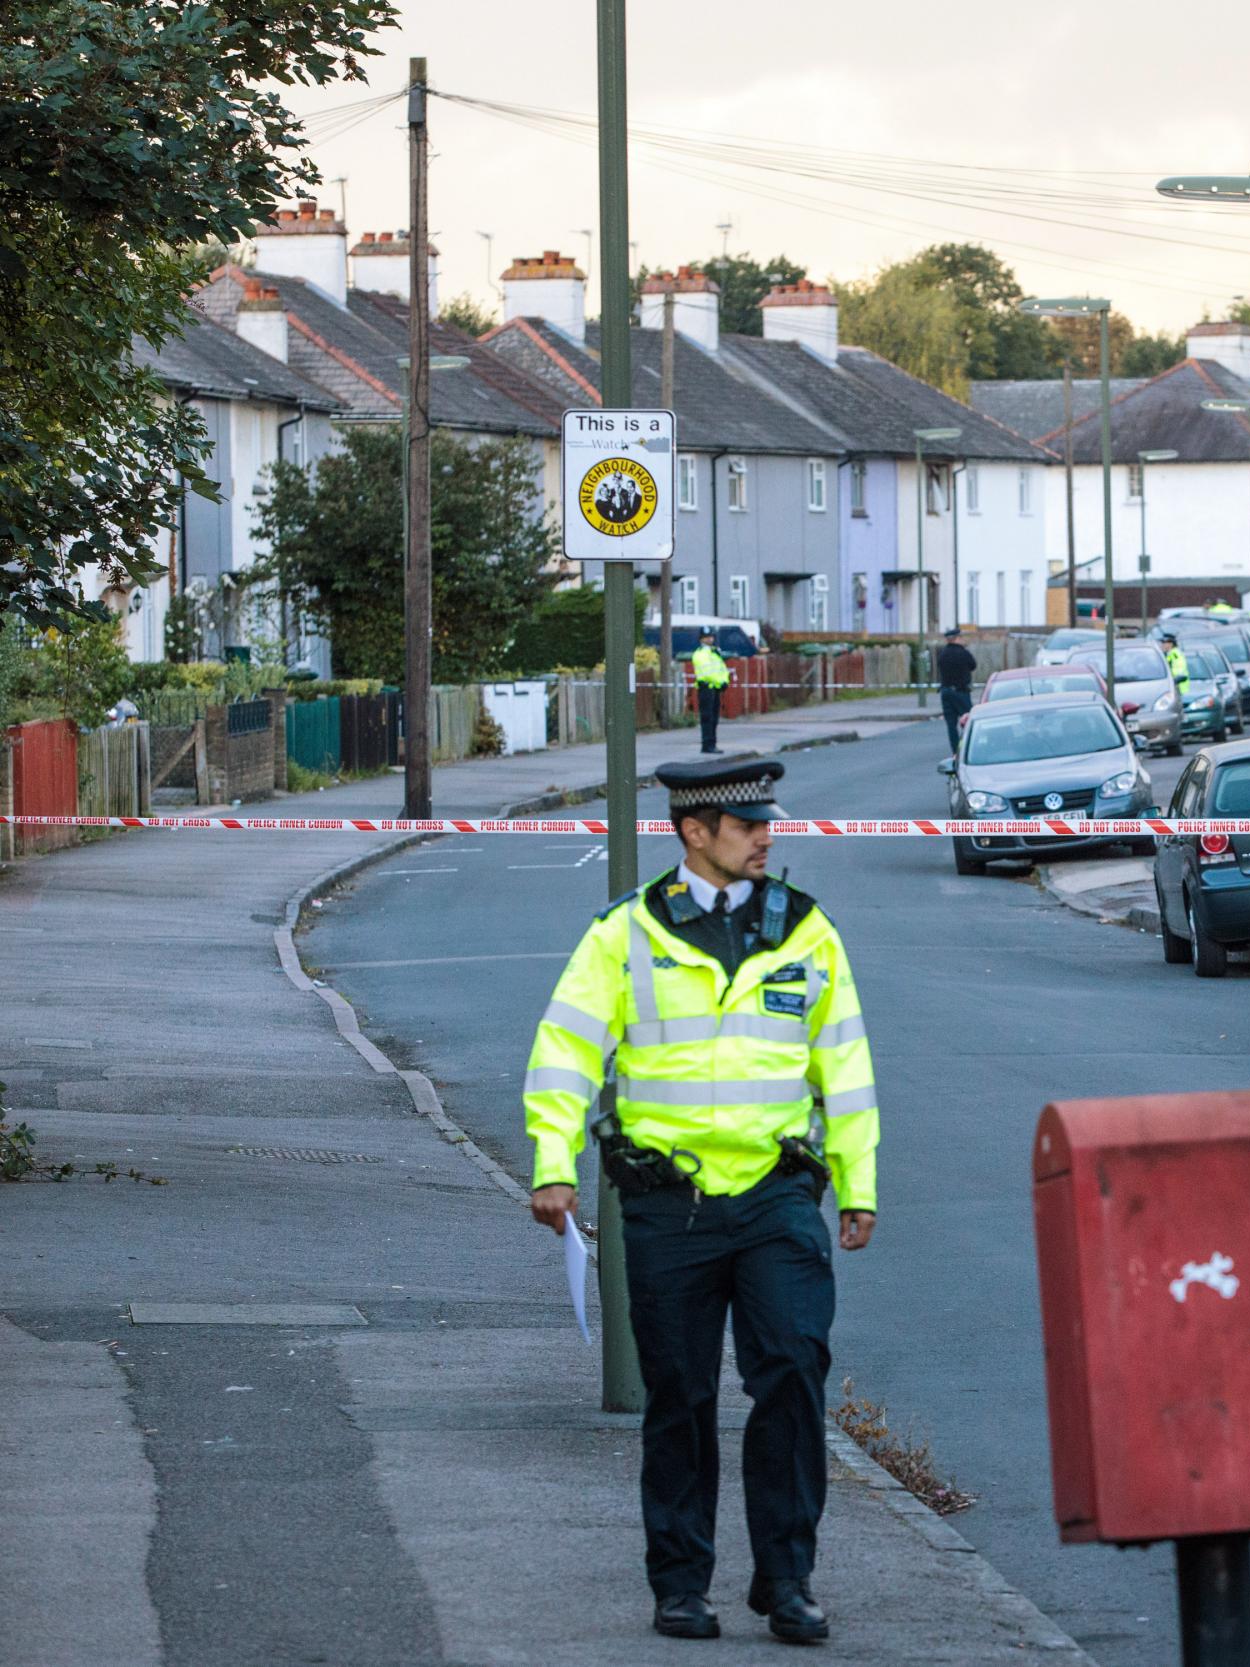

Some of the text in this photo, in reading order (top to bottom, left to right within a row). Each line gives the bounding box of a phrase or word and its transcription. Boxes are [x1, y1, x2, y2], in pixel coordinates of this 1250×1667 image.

[576, 415, 660, 431] This is a
[582, 460, 655, 503] NEIGHBOURHOOD
[598, 520, 639, 535] WATCH
[75, 817, 110, 825] CORDON
[148, 818, 159, 826] DO
[181, 819, 210, 827] CROSS
[247, 819, 343, 829] POLICE INNER CORDON
[382, 820, 444, 830] DO NOT CROSS
[481, 821, 577, 831] POLICE INNER CORDON
[636, 822, 645, 832] OT
[774, 822, 809, 832] CORDON
[846, 822, 908, 833] DO NOT CROSS
[945, 822, 1041, 833] POLICE INNER CORDON
[1079, 821, 1141, 833] DO NOT CROSS
[1178, 821, 1207, 832] POLICE
[1210, 821, 1237, 832] INNER
